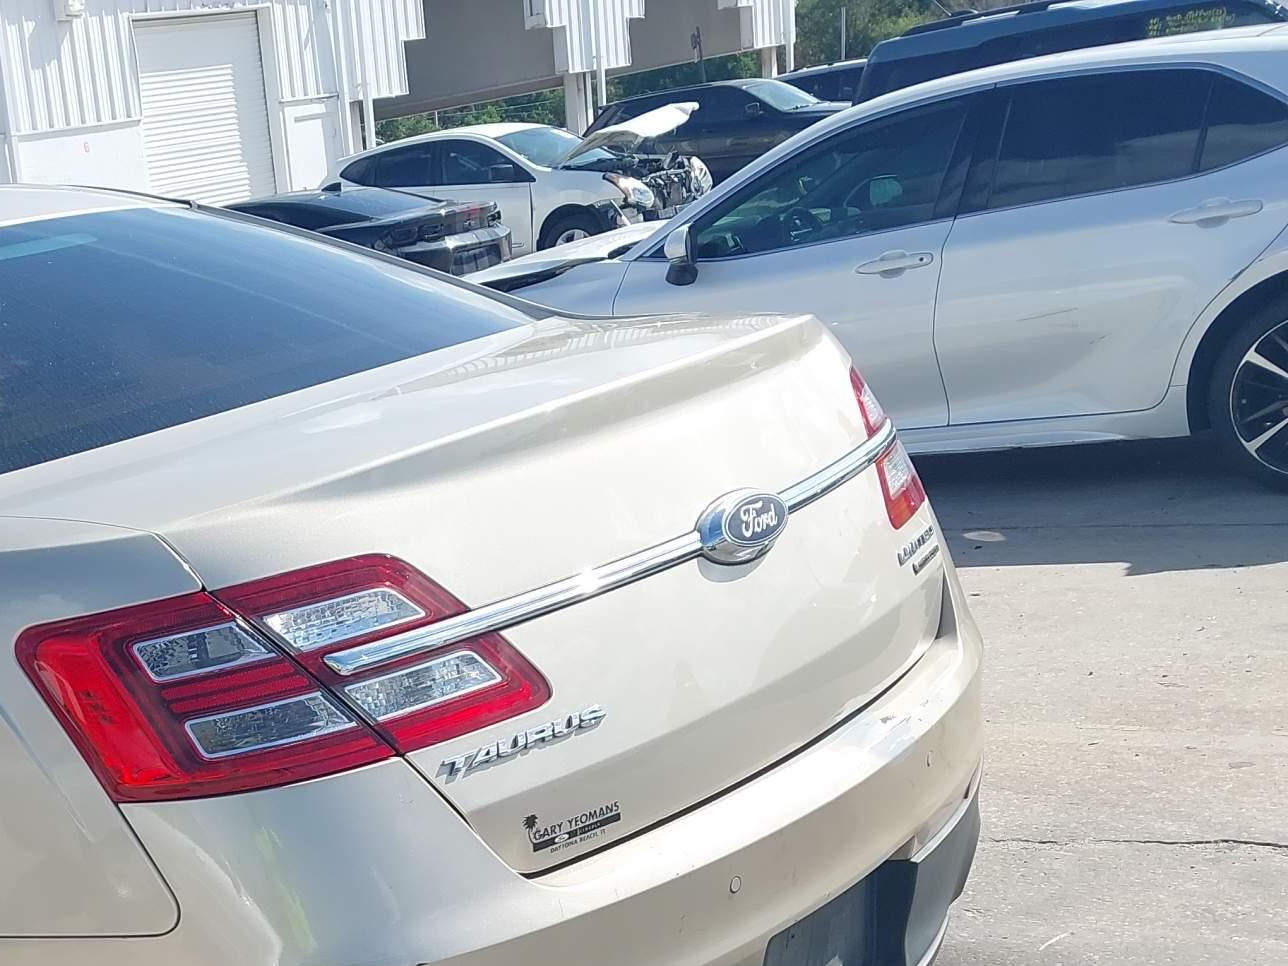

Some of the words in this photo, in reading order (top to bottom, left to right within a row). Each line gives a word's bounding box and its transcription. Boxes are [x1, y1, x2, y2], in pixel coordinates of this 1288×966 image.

[740, 500, 778, 538] Ford
[439, 704, 607, 779] TAURUS
[533, 822, 563, 841] GARY
[567, 801, 620, 829] YEOMANS
